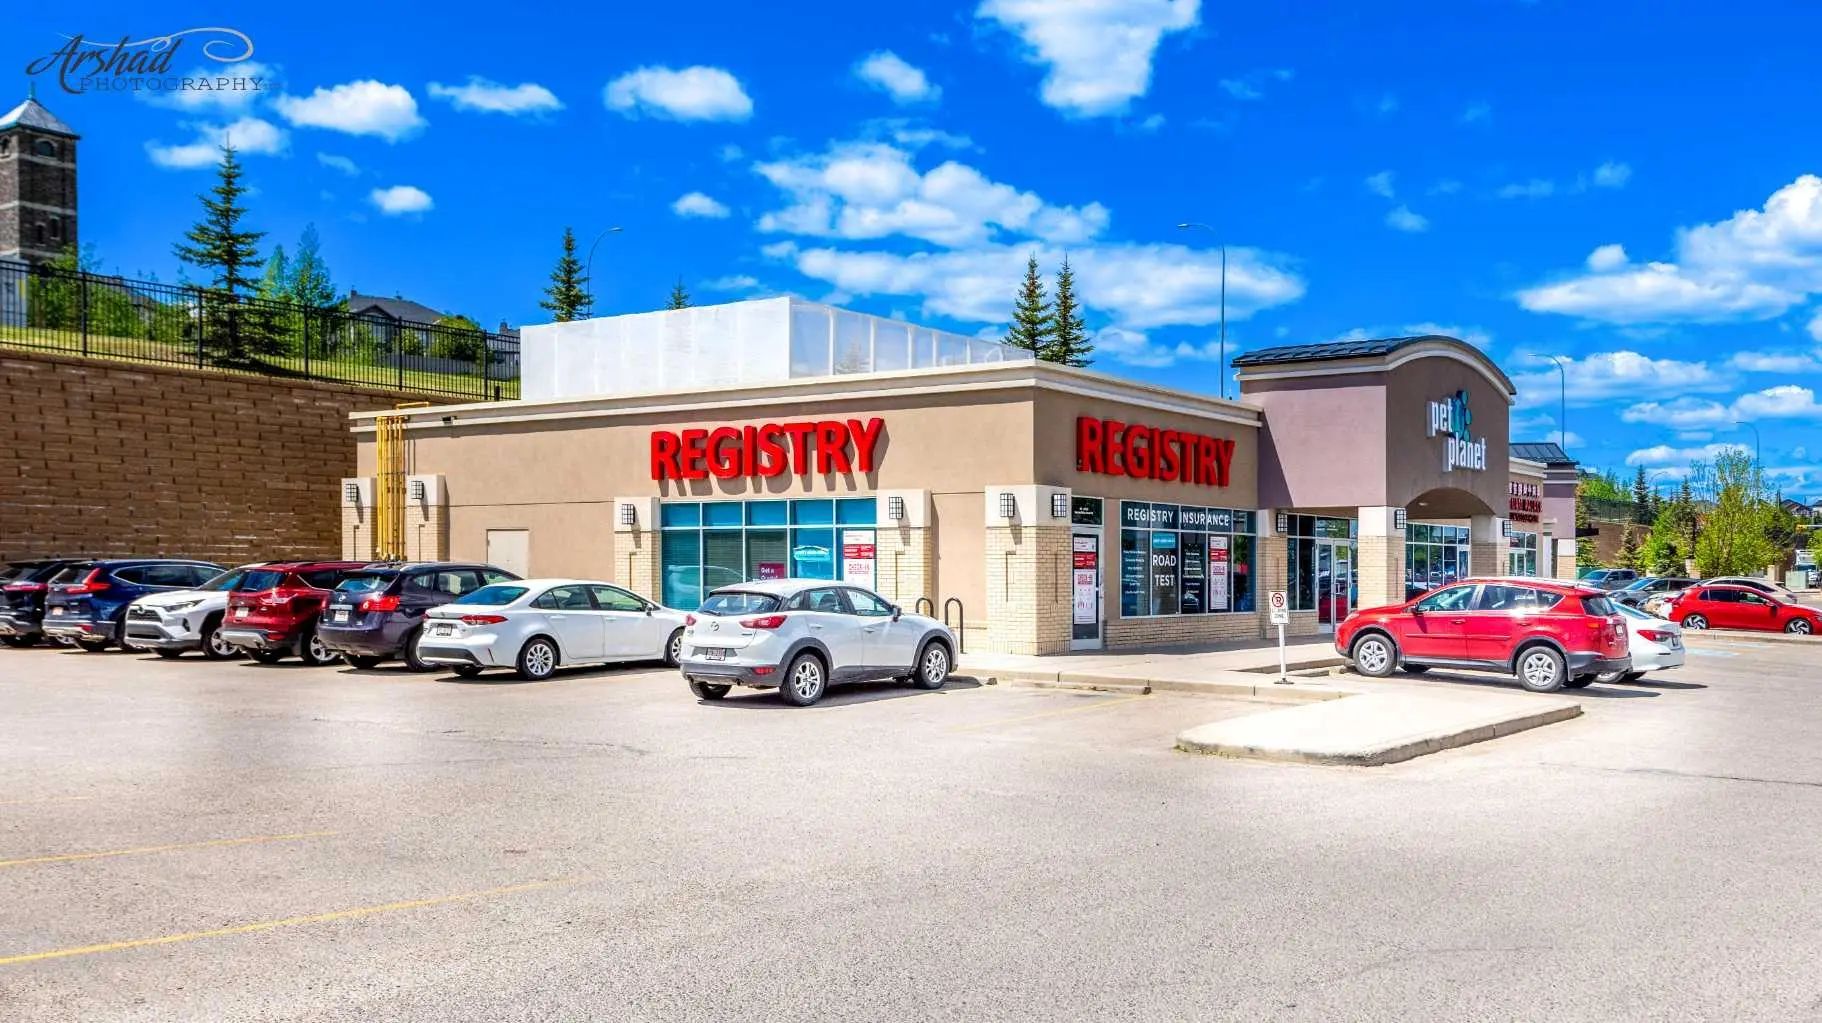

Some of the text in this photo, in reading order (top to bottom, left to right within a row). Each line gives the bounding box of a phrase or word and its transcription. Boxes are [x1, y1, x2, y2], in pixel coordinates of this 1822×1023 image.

[1429, 398, 1453, 438] pet
[651, 417, 885, 481] REGISTRY
[1076, 416, 1235, 487] REGISTRY
[1446, 431, 1487, 472] planet
[1127, 507, 1230, 527] REGISTRY INSURANCE
[1152, 554, 1177, 567] ROAD
[1154, 574, 1175, 587] TEST
